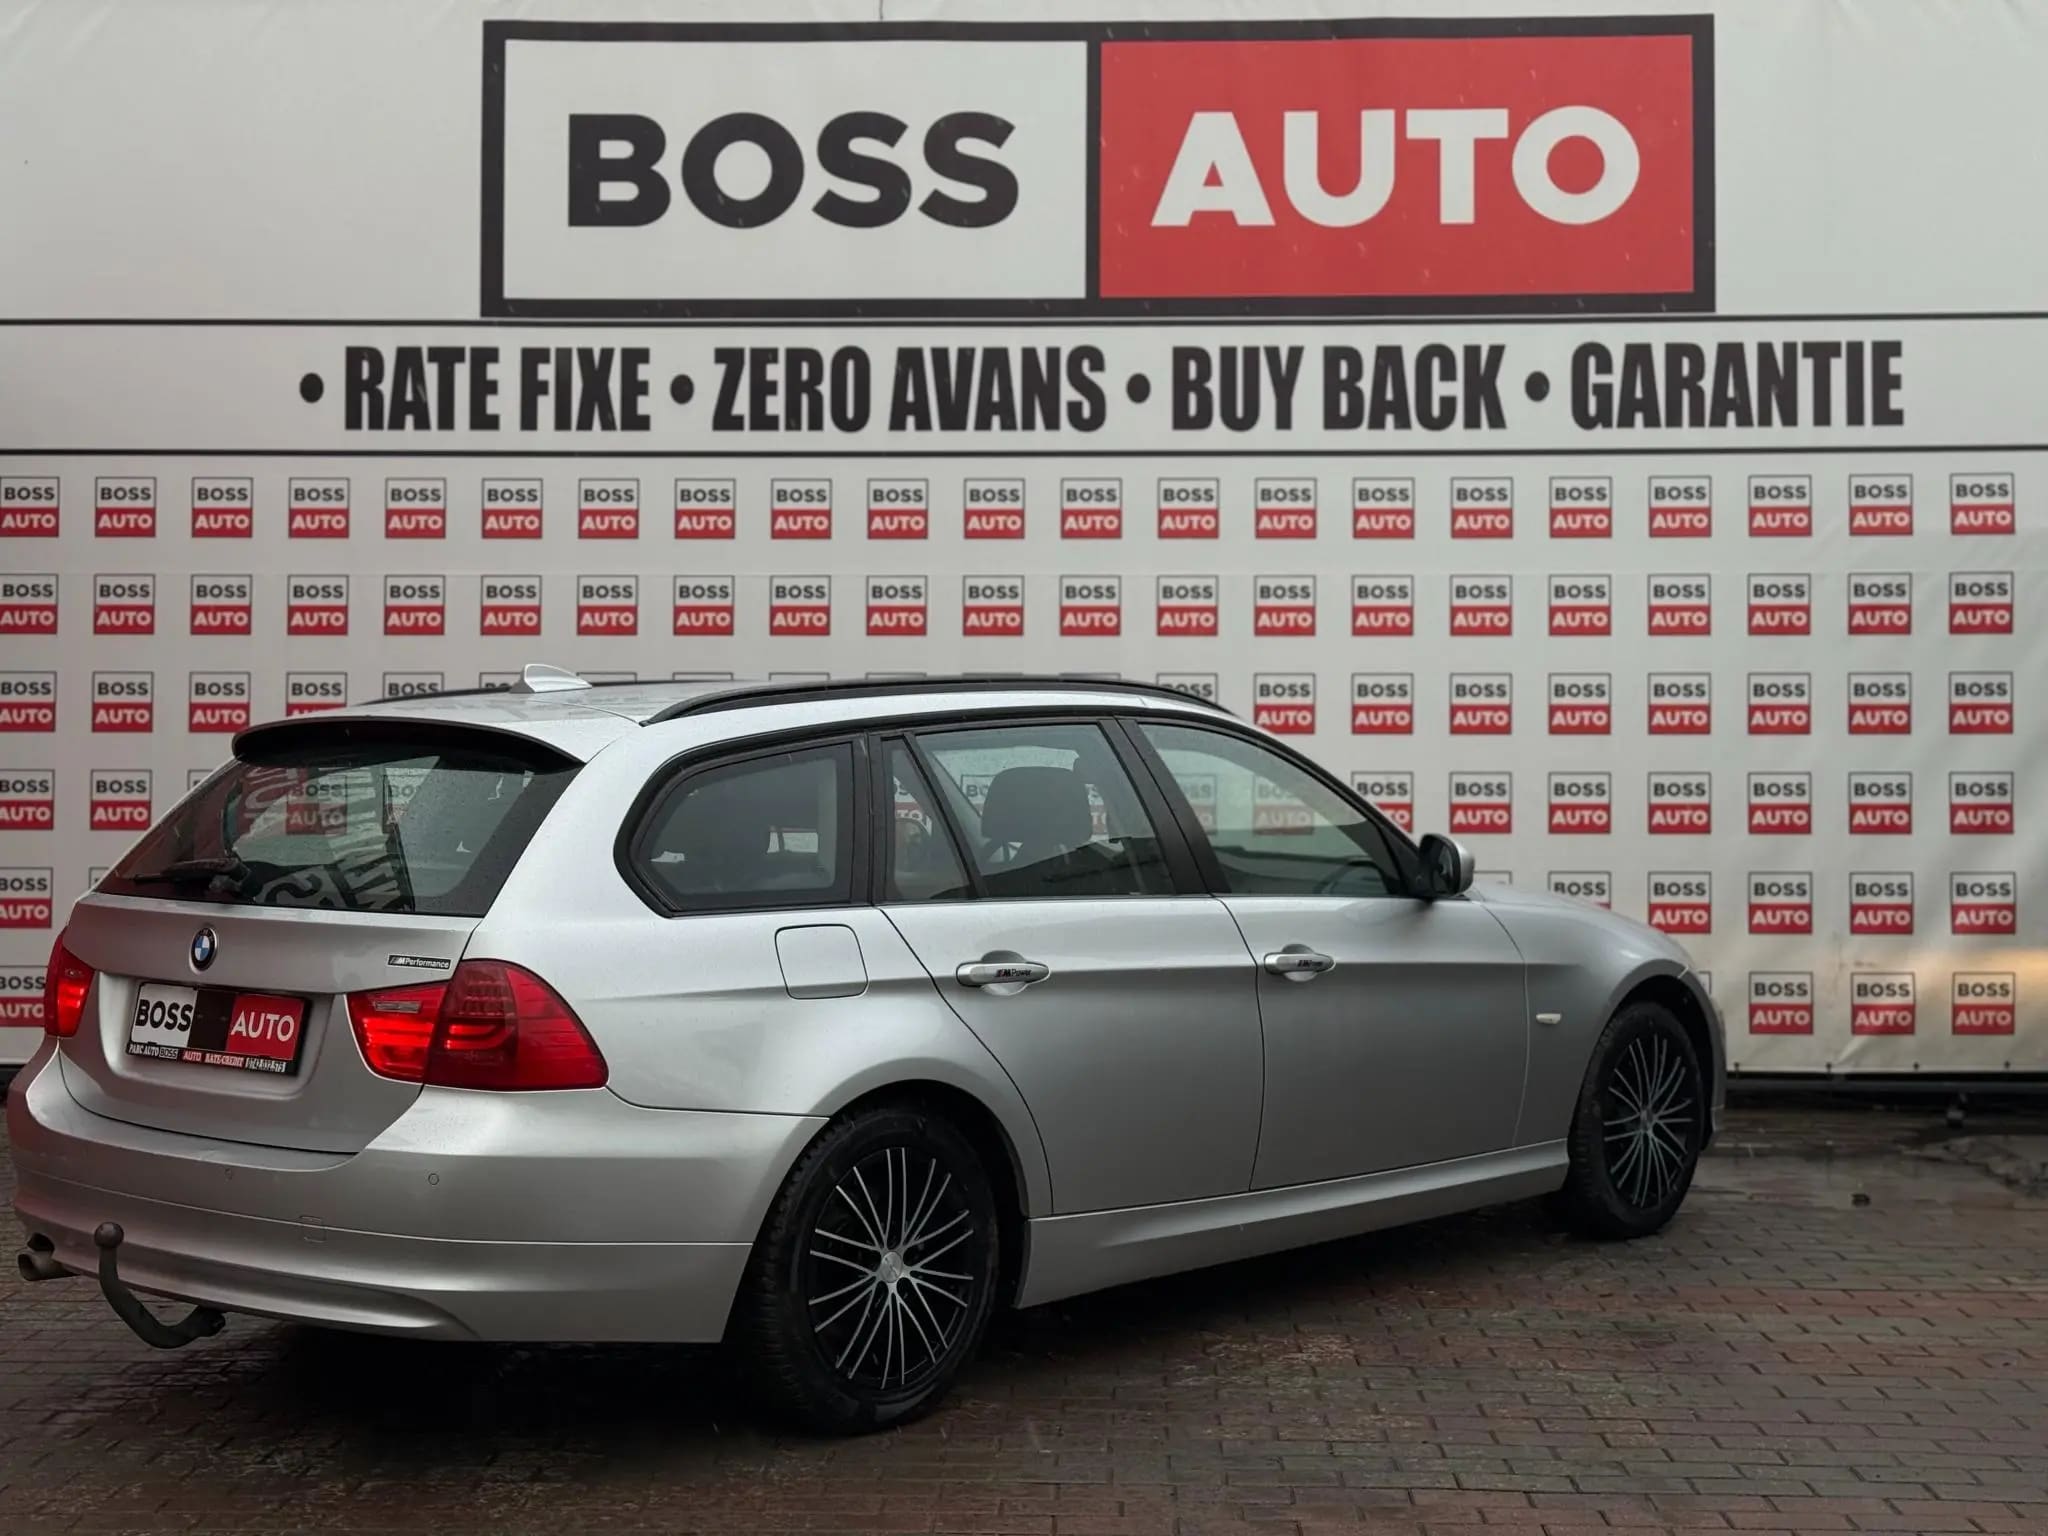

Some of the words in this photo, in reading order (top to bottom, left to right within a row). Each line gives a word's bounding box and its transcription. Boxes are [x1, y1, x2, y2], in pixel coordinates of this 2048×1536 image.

[568, 112, 1018, 228] BOSS
[1152, 106, 1639, 226] AUTO
[345, 347, 499, 430] RATE
[520, 348, 650, 431] FIXE
[713, 346, 870, 432] ZERO
[889, 346, 1106, 432] AVANS
[1173, 347, 1303, 431] BUY
[1324, 344, 1506, 430] BACK
[1572, 341, 1903, 430] GARANTIE
[5, 488, 54, 500] BOSS
[101, 488, 150, 500] BOSS
[198, 488, 247, 500] BOSS
[295, 489, 344, 501] BOSS
[391, 489, 440, 501] BOSS
[488, 489, 537, 501] BOSS
[584, 489, 633, 502] BOSS
[681, 489, 730, 502] BOSS
[777, 489, 826, 502] BOSS
[873, 490, 923, 502] BOSS
[970, 489, 1019, 502] BOSS
[1067, 489, 1116, 501] BOSS
[1164, 489, 1213, 501] BOSS
[1261, 489, 1311, 501] BOSS
[1359, 488, 1409, 501] BOSS
[1457, 488, 1507, 501] BOSS
[1556, 488, 1606, 500] BOSS
[1655, 487, 1705, 499] BOSS
[1755, 486, 1806, 499] BOSS
[1855, 485, 1907, 498] BOSS
[1956, 484, 2008, 497] BOSS
[2, 514, 56, 528] AUTO
[99, 514, 152, 528] AUTO
[195, 515, 249, 528] AUTO
[292, 515, 346, 529] AUTO
[389, 516, 442, 529] AUTO
[486, 516, 539, 529] AUTO
[582, 516, 636, 529] AUTO
[678, 516, 732, 529] AUTO
[775, 516, 828, 530] AUTO
[871, 516, 925, 530] AUTO
[968, 516, 1021, 530] AUTO
[1065, 516, 1118, 529] AUTO
[1161, 515, 1215, 529] AUTO
[1259, 516, 1313, 529] AUTO
[1357, 515, 1411, 529] AUTO
[1455, 515, 1509, 529] AUTO
[1554, 515, 1608, 528] AUTO
[1653, 514, 1708, 528] AUTO
[1752, 513, 1808, 527] AUTO
[1853, 512, 1909, 526] AUTO
[1955, 511, 2011, 525] AUTO
[3, 584, 52, 597] BOSS
[100, 585, 149, 597] BOSS
[197, 585, 246, 598] BOSS
[294, 586, 343, 598] BOSS
[390, 586, 439, 598] BOSS
[583, 586, 632, 598] BOSS
[680, 586, 728, 598] BOSS
[776, 586, 825, 598] BOSS
[872, 586, 921, 598] BOSS
[969, 586, 1018, 598] BOSS
[1066, 586, 1115, 598] BOSS
[1163, 586, 1212, 598] BOSS
[1260, 586, 1310, 598] BOSS
[1456, 586, 1506, 598] BOSS
[1555, 586, 1605, 598] BOSS
[1654, 585, 1705, 597] BOSS
[1754, 584, 1805, 597] BOSS
[1854, 584, 1905, 596] BOSS
[1955, 583, 2007, 596] BOSS
[0, 611, 54, 625] AUTO
[97, 612, 151, 625] AUTO
[194, 612, 248, 626] AUTO
[291, 612, 345, 626] AUTO
[388, 612, 441, 626] AUTO
[581, 612, 634, 626] AUTO
[677, 612, 730, 626] AUTO
[773, 613, 827, 626] AUTO
[870, 613, 924, 626] AUTO
[966, 613, 1020, 626] AUTO
[1063, 613, 1117, 626] AUTO
[1160, 613, 1215, 626] AUTO
[1258, 613, 1312, 626] AUTO
[1454, 613, 1509, 626] AUTO
[1553, 612, 1608, 626] AUTO
[1652, 612, 1707, 626] AUTO
[1752, 612, 1807, 626] AUTO
[1852, 611, 1908, 625] AUTO
[1953, 610, 2010, 624] AUTO
[1, 682, 51, 695] BOSS
[98, 683, 147, 695] BOSS
[195, 683, 244, 695] BOSS
[291, 682, 343, 696] BOSS
[1260, 684, 1310, 697] BOSS
[1358, 684, 1407, 697] BOSS
[1456, 684, 1506, 697] BOSS
[1555, 684, 1605, 697] BOSS
[1654, 684, 1705, 696] BOSS
[1754, 684, 1805, 696] BOSS
[1854, 684, 1905, 696] BOSS
[1955, 683, 2007, 696] BOSS
[0, 709, 52, 723] AUTO
[96, 709, 149, 723] AUTO
[192, 710, 246, 723] AUTO
[1257, 711, 1312, 725] AUTO
[1355, 711, 1410, 725] AUTO
[1454, 711, 1508, 725] AUTO
[1552, 711, 1607, 725] AUTO
[1652, 711, 1707, 725] AUTO
[1752, 711, 1807, 725] AUTO
[1852, 711, 1907, 725] AUTO
[1953, 710, 2010, 724] AUTO
[0, 780, 48, 792] BOSS
[97, 781, 146, 793] BOSS
[1455, 783, 1506, 796] BOSS
[1554, 783, 1605, 796] BOSS
[1654, 783, 1705, 796] BOSS
[1754, 783, 1805, 796] BOSS
[1855, 784, 1906, 796] BOSS
[1956, 783, 2008, 796] BOSS
[94, 807, 148, 821] AUTO
[1453, 810, 1508, 824] AUTO
[1552, 810, 1608, 824] AUTO
[1652, 810, 1708, 824] AUTO
[1752, 811, 1808, 824] AUTO
[1853, 811, 1908, 825] AUTO
[1954, 811, 2010, 825] AUTO
[1654, 883, 1705, 896] BOSS
[1754, 883, 1806, 896] BOSS
[1856, 883, 1907, 896] BOSS
[1956, 883, 2010, 896] BOSS
[1651, 910, 1708, 924] AUTO
[1752, 910, 1808, 924] AUTO
[1854, 911, 1909, 925] AUTO
[1955, 911, 2012, 924] AUTO
[1755, 983, 1807, 996] BOSS
[1857, 984, 1909, 997] BOSS
[1958, 984, 2009, 997] BOSS
[135, 999, 193, 1032] BOSS
[231, 1010, 295, 1042] AUTO
[1753, 1011, 1809, 1024] AUTO
[1856, 1011, 1911, 1025] AUTO
[1956, 1011, 2011, 1025] AUTO
